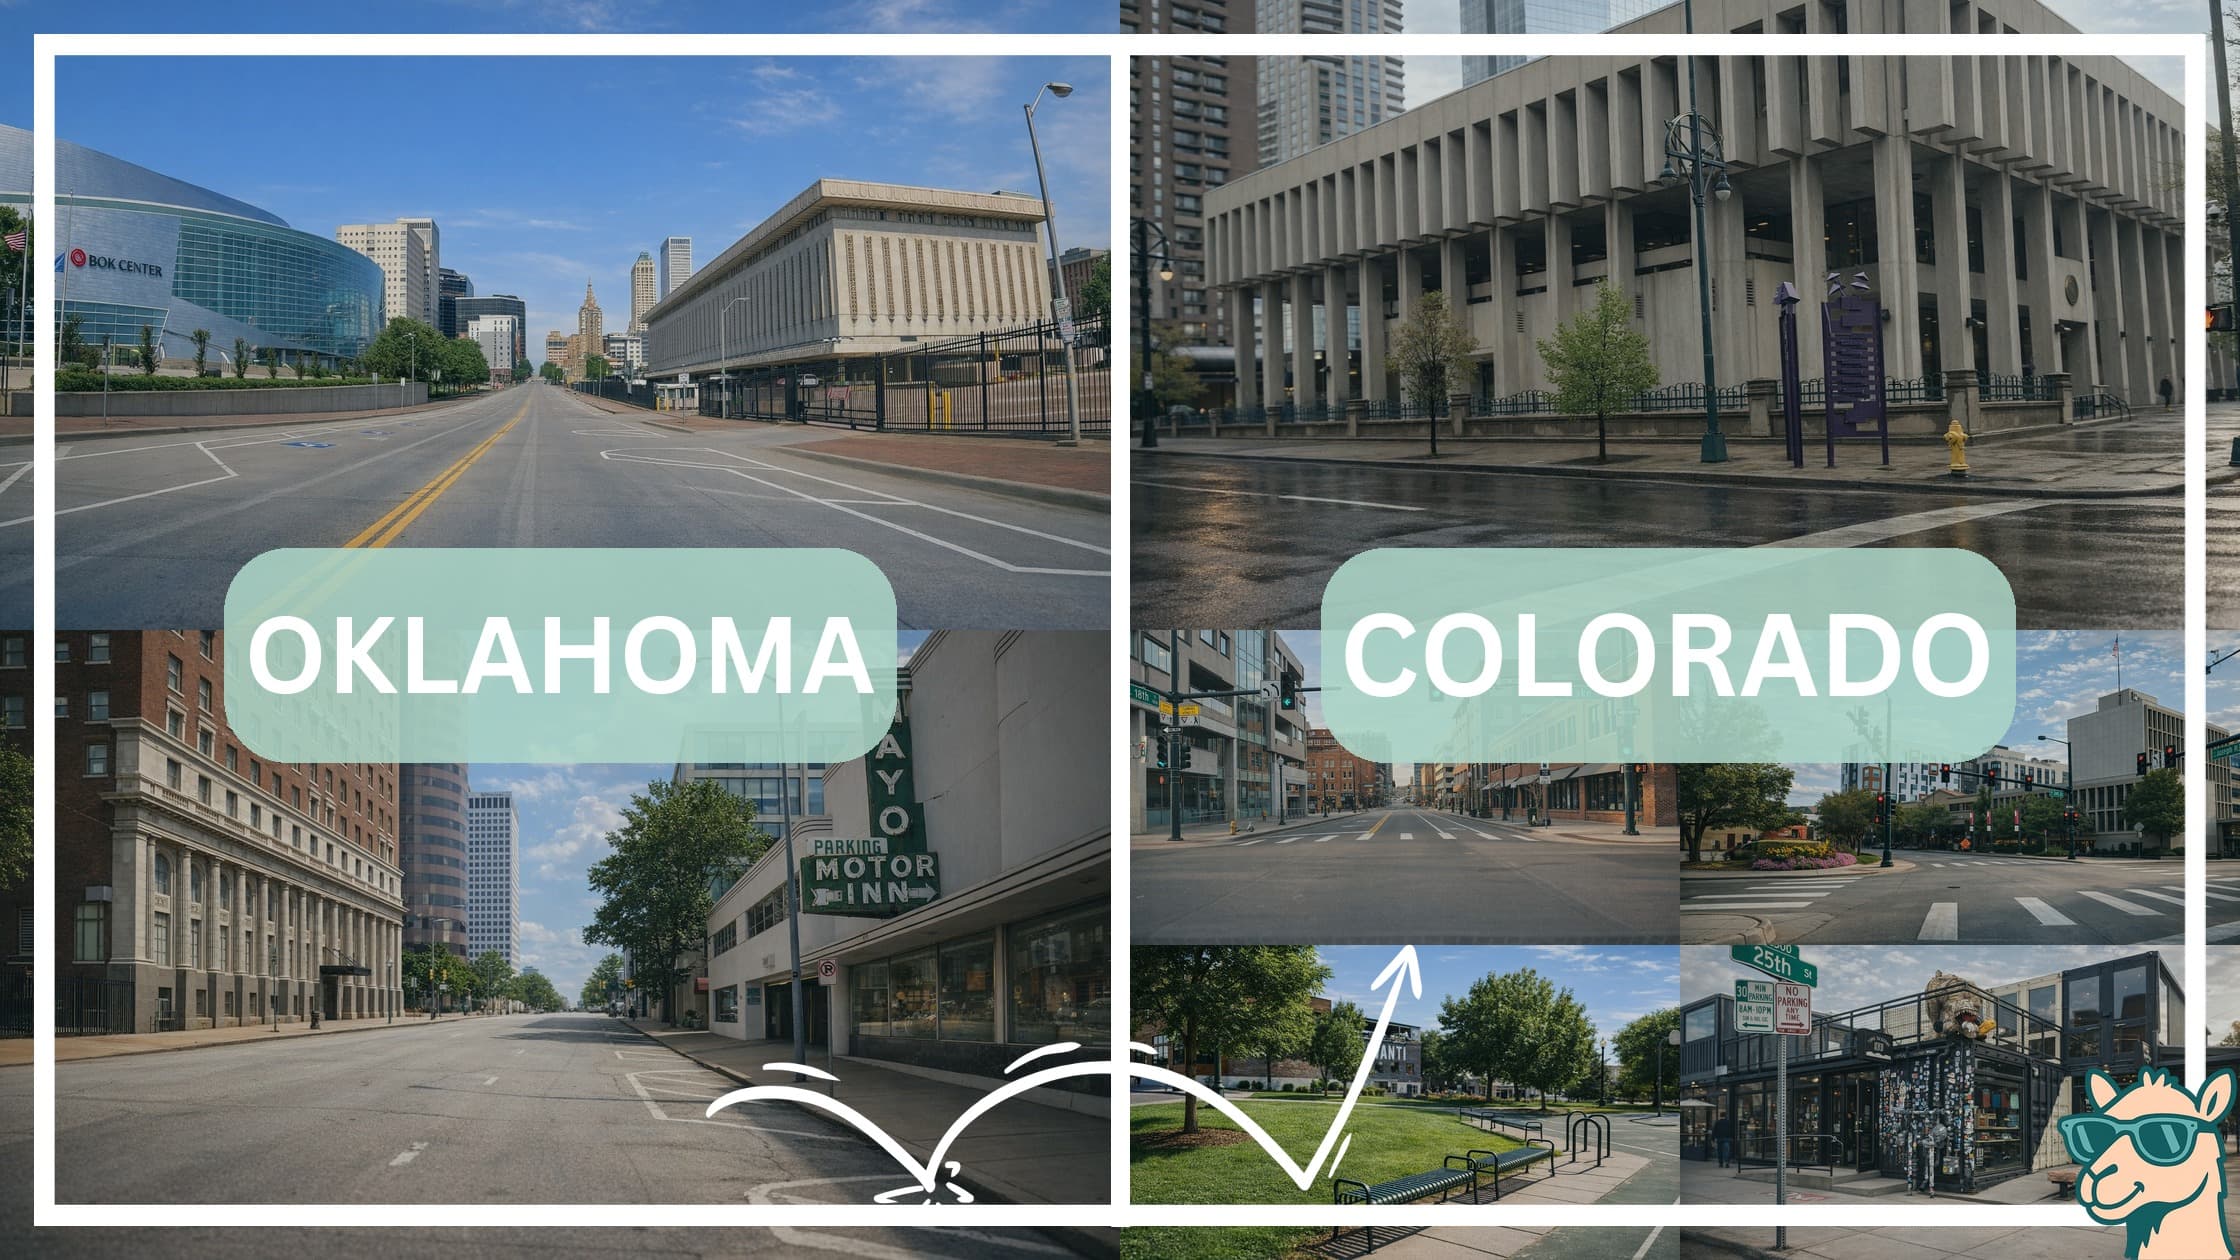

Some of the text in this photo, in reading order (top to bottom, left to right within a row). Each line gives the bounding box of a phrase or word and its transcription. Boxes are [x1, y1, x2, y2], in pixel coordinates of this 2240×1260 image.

[89, 254, 162, 277] BOK CENTER
[814, 840, 881, 855] PARKING
[816, 855, 935, 880] MOTOR
[847, 881, 909, 904] INN
[1753, 946, 1812, 979] 25th St
[1736, 985, 1748, 998] 30
[1754, 984, 1767, 992] MIN
[1785, 986, 1799, 996] NO
[1748, 992, 1773, 1001] PARKING
[1777, 997, 1808, 1008] PARKING
[1785, 1013, 1800, 1021] TIME
[1375, 1044, 1406, 1061] ANTI
